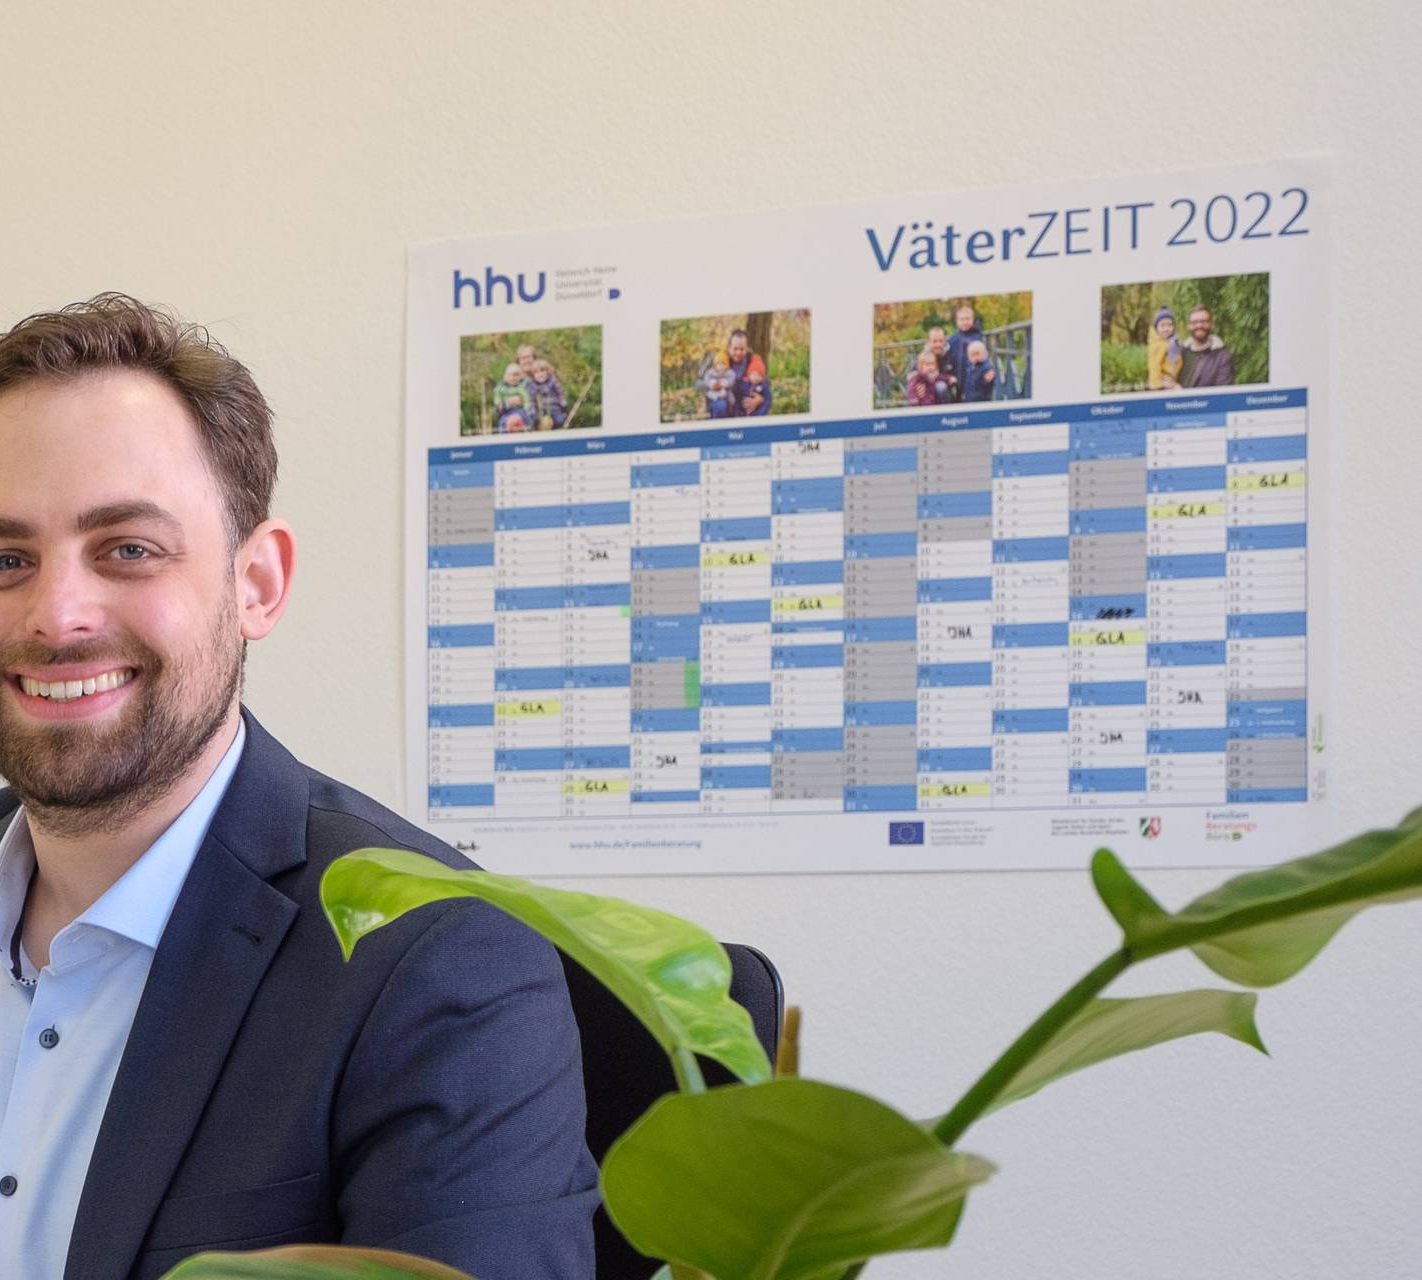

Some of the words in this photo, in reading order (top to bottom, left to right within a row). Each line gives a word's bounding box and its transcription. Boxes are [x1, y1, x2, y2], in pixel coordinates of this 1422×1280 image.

[865, 203, 1155, 272] VäterZEIT
[1165, 186, 1311, 247] 2022
[453, 267, 546, 309] hhu
[1259, 473, 1289, 488] GLA
[729, 555, 756, 566] GLA
[1096, 631, 1126, 645] GLA
[520, 703, 546, 714] GLA
